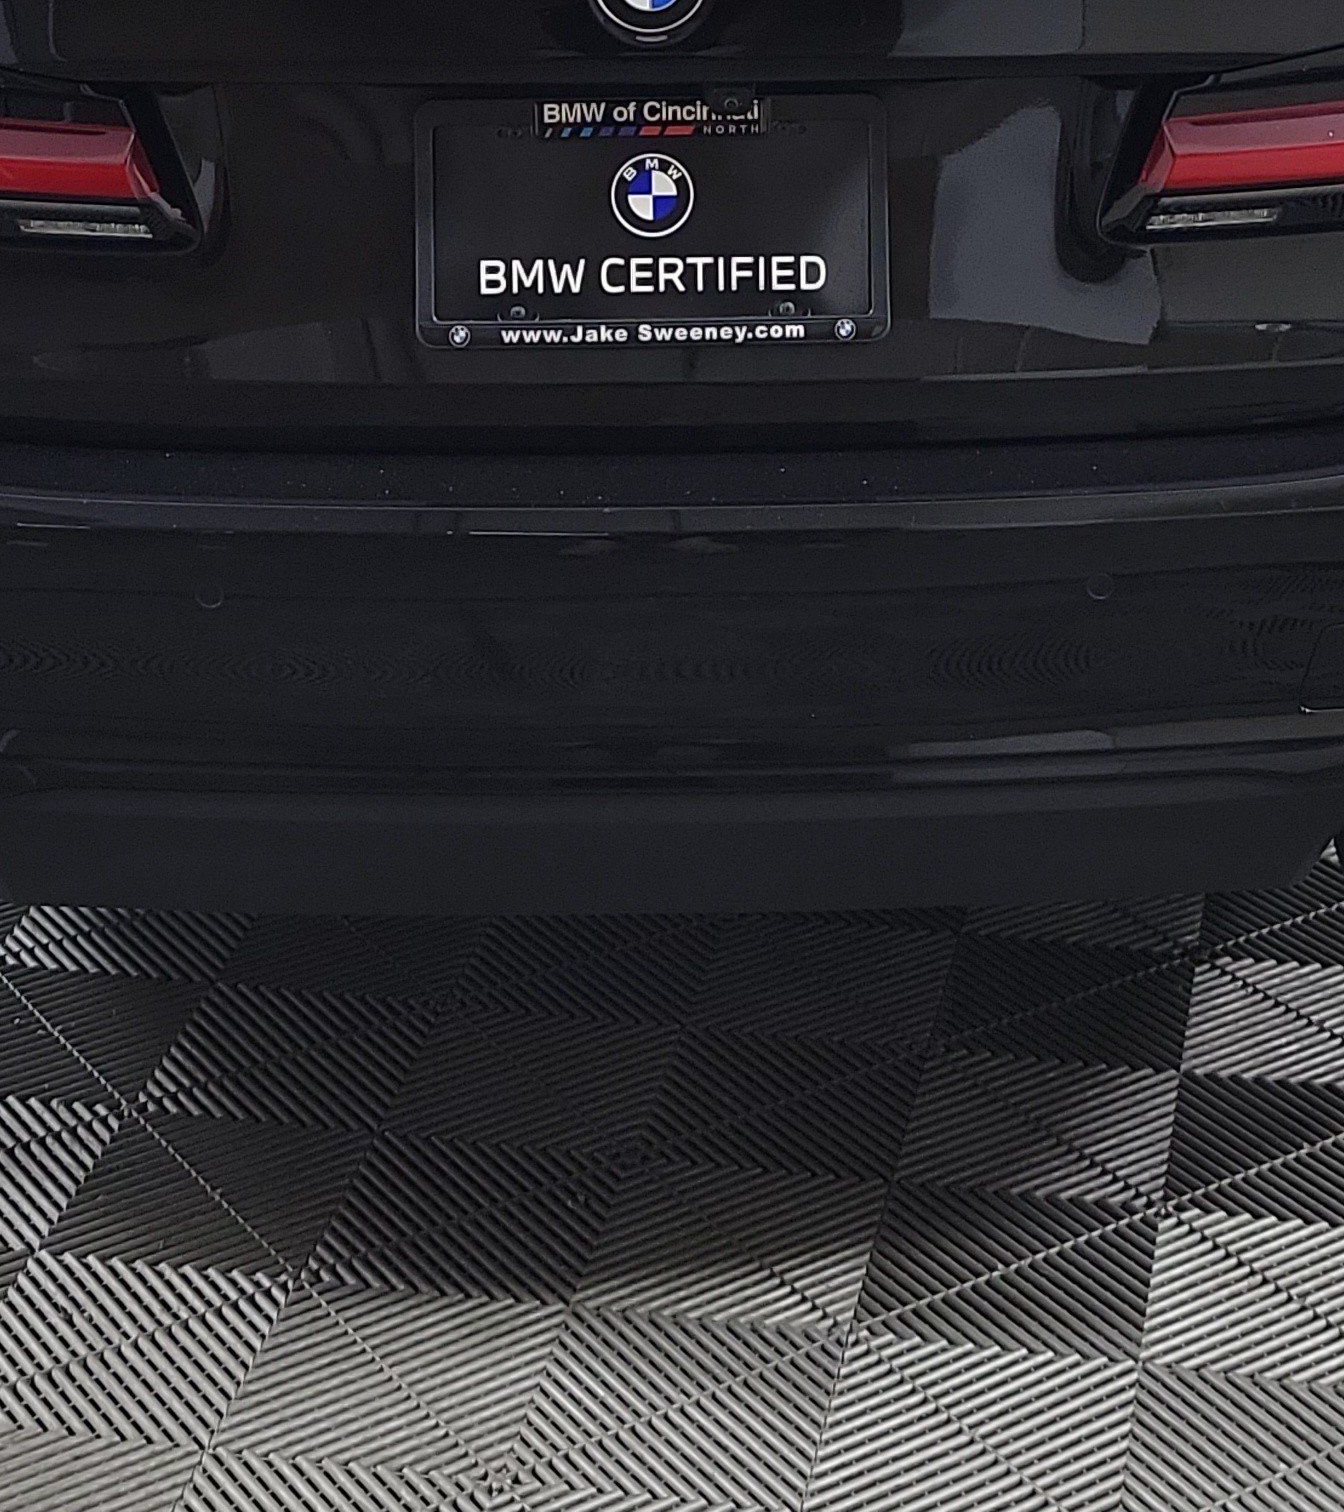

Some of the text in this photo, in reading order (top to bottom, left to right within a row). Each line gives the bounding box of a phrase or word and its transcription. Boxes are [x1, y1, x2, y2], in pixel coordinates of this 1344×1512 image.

[543, 102, 606, 123] BMW
[613, 101, 636, 122] of
[703, 124, 759, 135] NORTH
[623, 158, 682, 181] BMW
[479, 255, 827, 295] BMW CERTIFIED
[501, 324, 805, 344] www.Jake Sweeney.com
